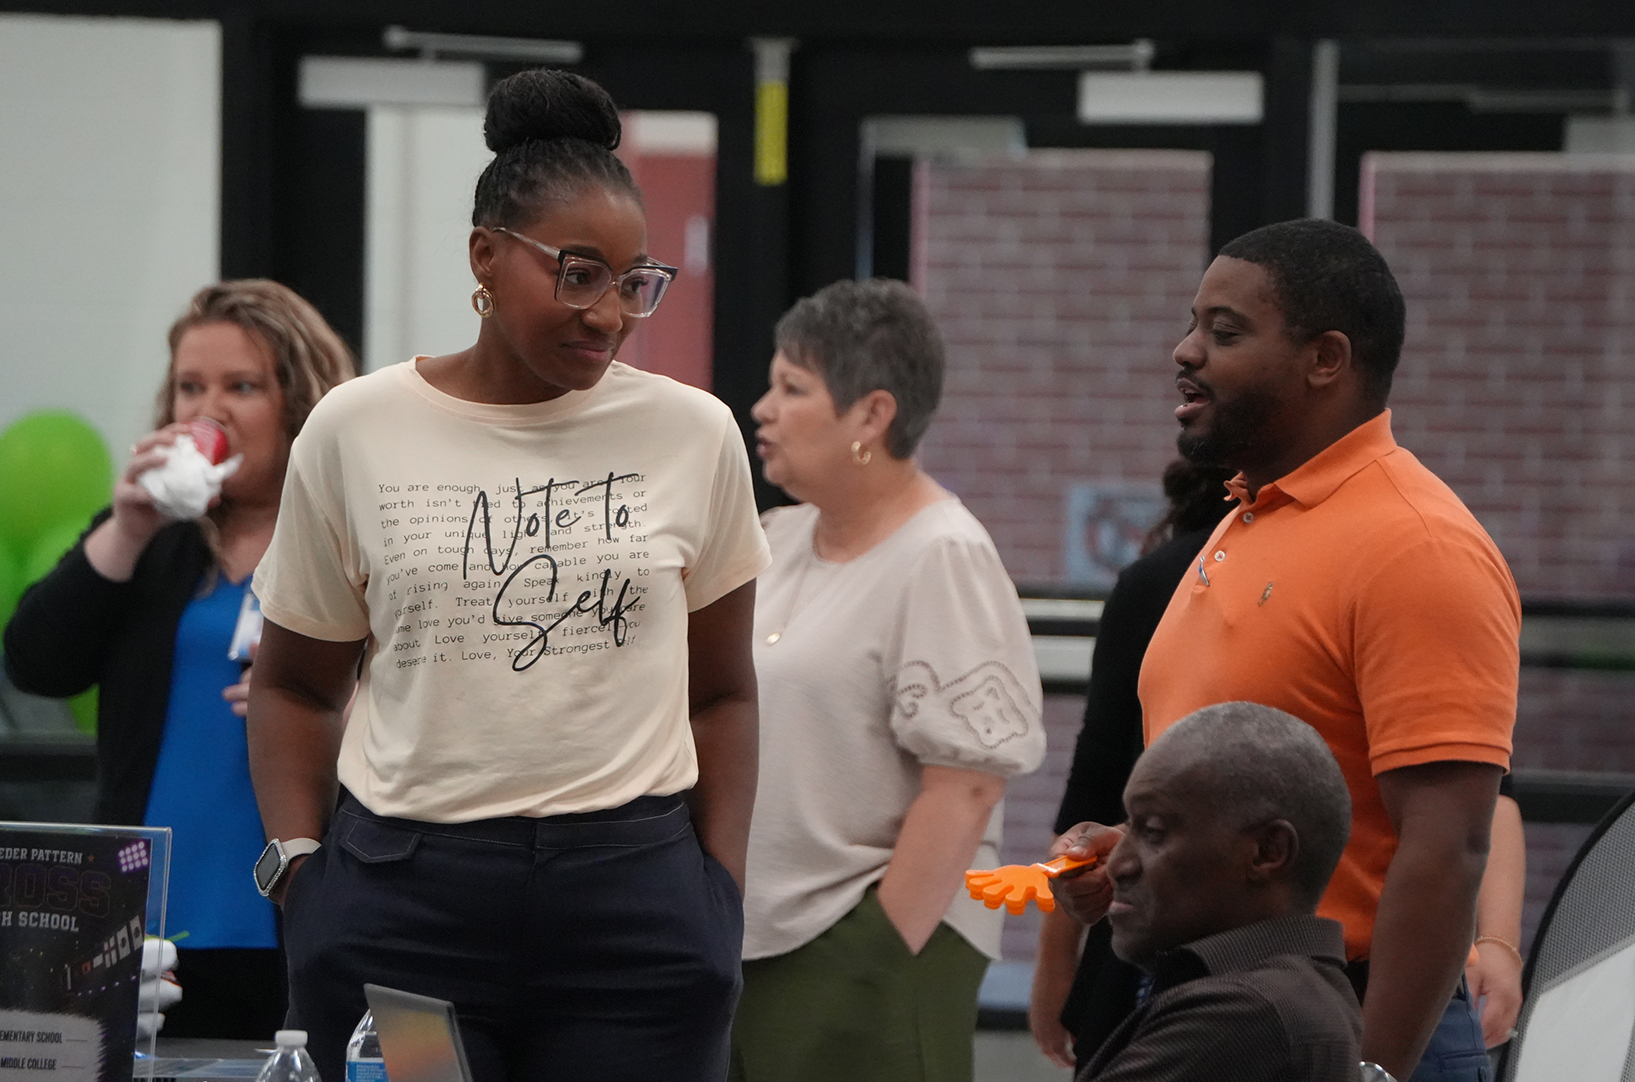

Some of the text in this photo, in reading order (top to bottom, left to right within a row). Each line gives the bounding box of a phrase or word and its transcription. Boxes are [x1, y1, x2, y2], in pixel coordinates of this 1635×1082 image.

[378, 484, 400, 493] You
[407, 484, 429, 492] are
[437, 484, 480, 494] enough
[496, 484, 523, 495] just
[553, 481, 576, 492] you
[379, 500, 414, 511] worth
[426, 498, 461, 508] isn't
[512, 500, 526, 508] to
[536, 491, 623, 507] achievements
[633, 490, 646, 498] or
[381, 518, 400, 529] the
[409, 515, 468, 525] opinions
[383, 537, 394, 547] in
[403, 531, 432, 544] your
[444, 529, 487, 540] unique
[550, 527, 572, 536] and
[384, 552, 406, 566] Even
[413, 548, 428, 557] on
[437, 545, 475, 556] tough
[530, 540, 588, 554] remember
[597, 537, 620, 545] how
[630, 534, 648, 543] far
[386, 567, 418, 586] you've
[428, 562, 459, 572] come
[468, 562, 492, 571] and
[597, 553, 619, 564] you
[629, 551, 649, 559] are
[388, 590, 397, 600] of
[406, 581, 448, 596] rising
[523, 577, 559, 589] Speak
[637, 567, 650, 576] to
[455, 596, 492, 606] Treat
[629, 585, 648, 595] the
[418, 619, 440, 629] love
[447, 614, 485, 628] you'd
[531, 610, 583, 622] someone
[493, 554, 640, 671] Self
[393, 639, 421, 651] about
[434, 635, 465, 644] Love
[433, 652, 452, 662] it.
[461, 651, 497, 661] Love,
[507, 648, 536, 658] Your
[543, 641, 610, 656] Strongest
[31, 848, 83, 864] PATTERN
[18, 911, 80, 932] SCHOOL
[36, 1031, 63, 1043] SCHOOL
[0, 1056, 57, 1070] MIDDLE COLLEGE
